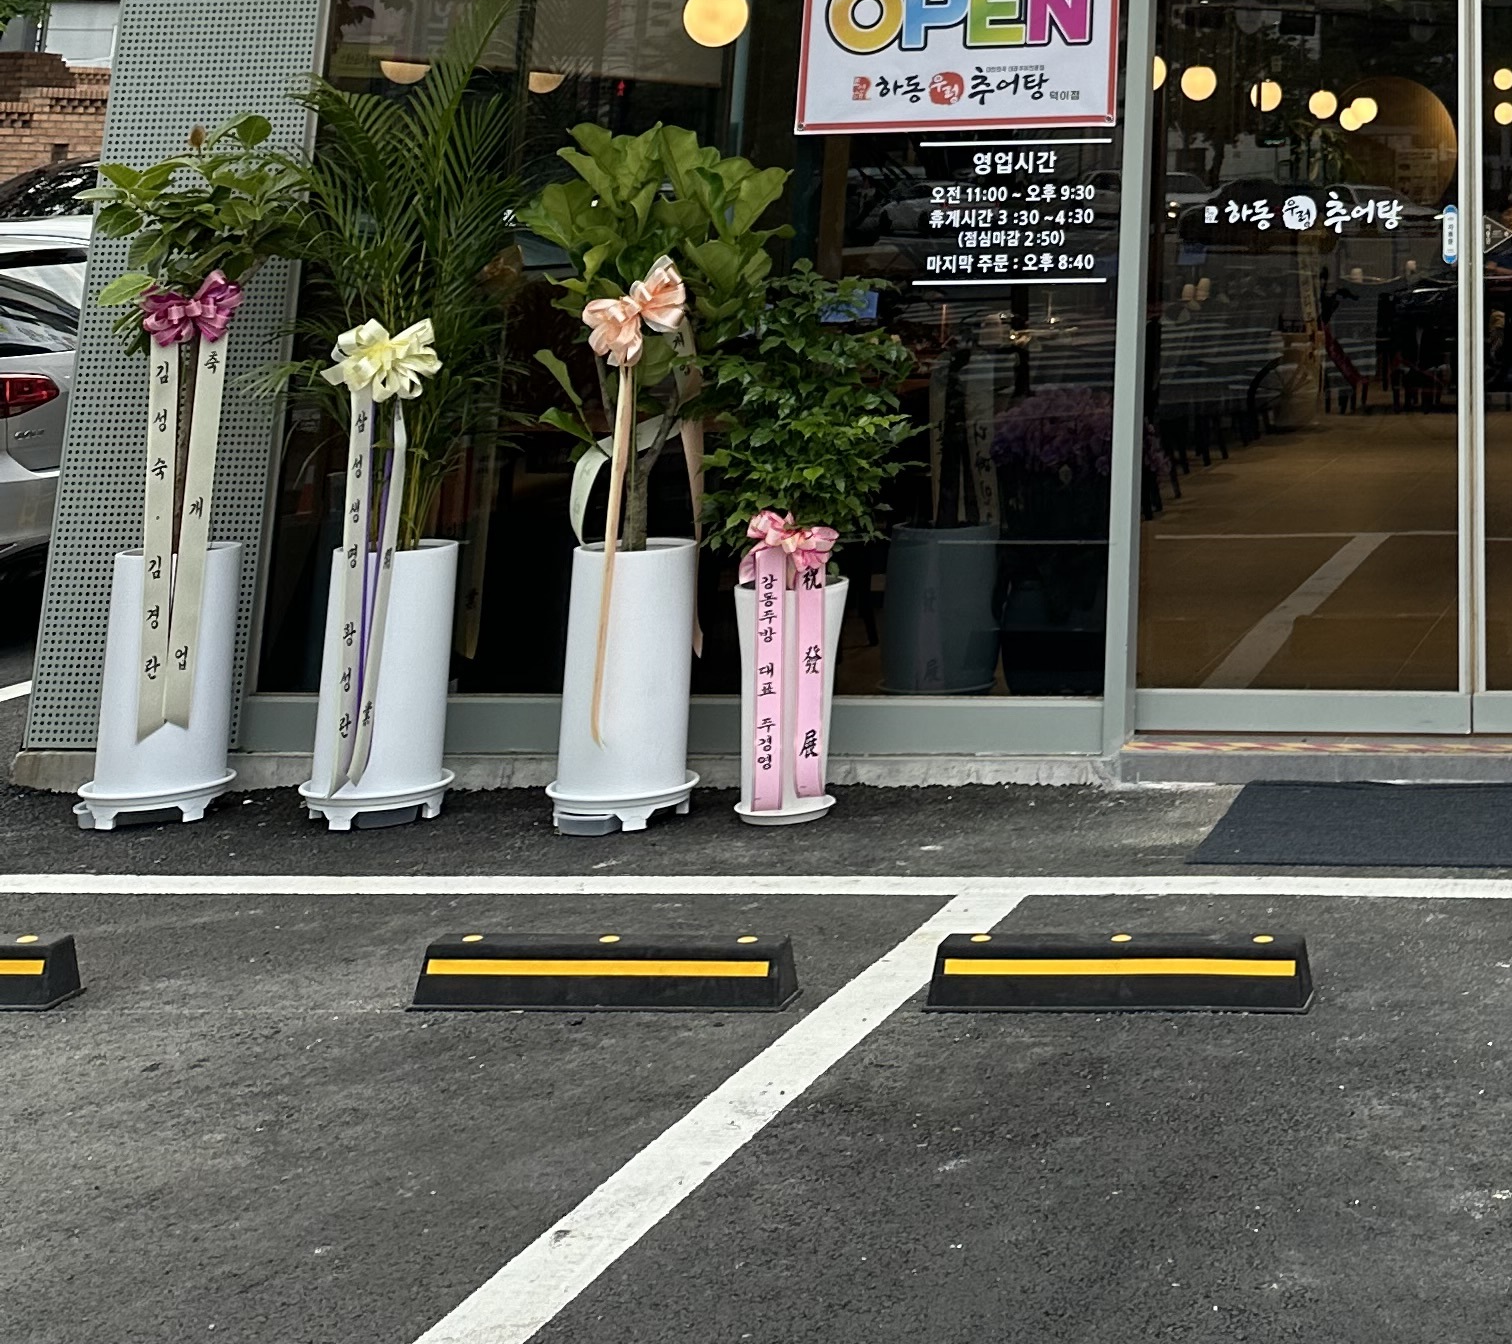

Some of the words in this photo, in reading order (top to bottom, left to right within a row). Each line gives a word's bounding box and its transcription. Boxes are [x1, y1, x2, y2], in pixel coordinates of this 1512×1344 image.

[875, 74, 926, 104] 하동
[931, 74, 959, 105] 우렁
[967, 66, 1050, 106] 추어탕
[1049, 90, 1081, 102] 덕이점
[973, 151, 1057, 175] 영업시간
[930, 186, 961, 205] 오전
[966, 186, 1008, 203] 11:00
[1025, 184, 1057, 203] 오후
[1060, 184, 1096, 201] 9:30
[1224, 199, 1275, 231] 하동
[1323, 190, 1404, 234] 추어탕
[928, 209, 993, 229] 휴게시간
[957, 231, 1021, 249] (점심마감
[926, 254, 974, 274] 마지막
[977, 254, 1009, 273] 주문
[1022, 253, 1055, 272] 오후
[1057, 254, 1095, 271] 8:40
[347, 410, 368, 570] 삼성생명
[143, 555, 164, 681] 김경란
[338, 620, 357, 740] 황성란
[757, 662, 777, 697] 대표
